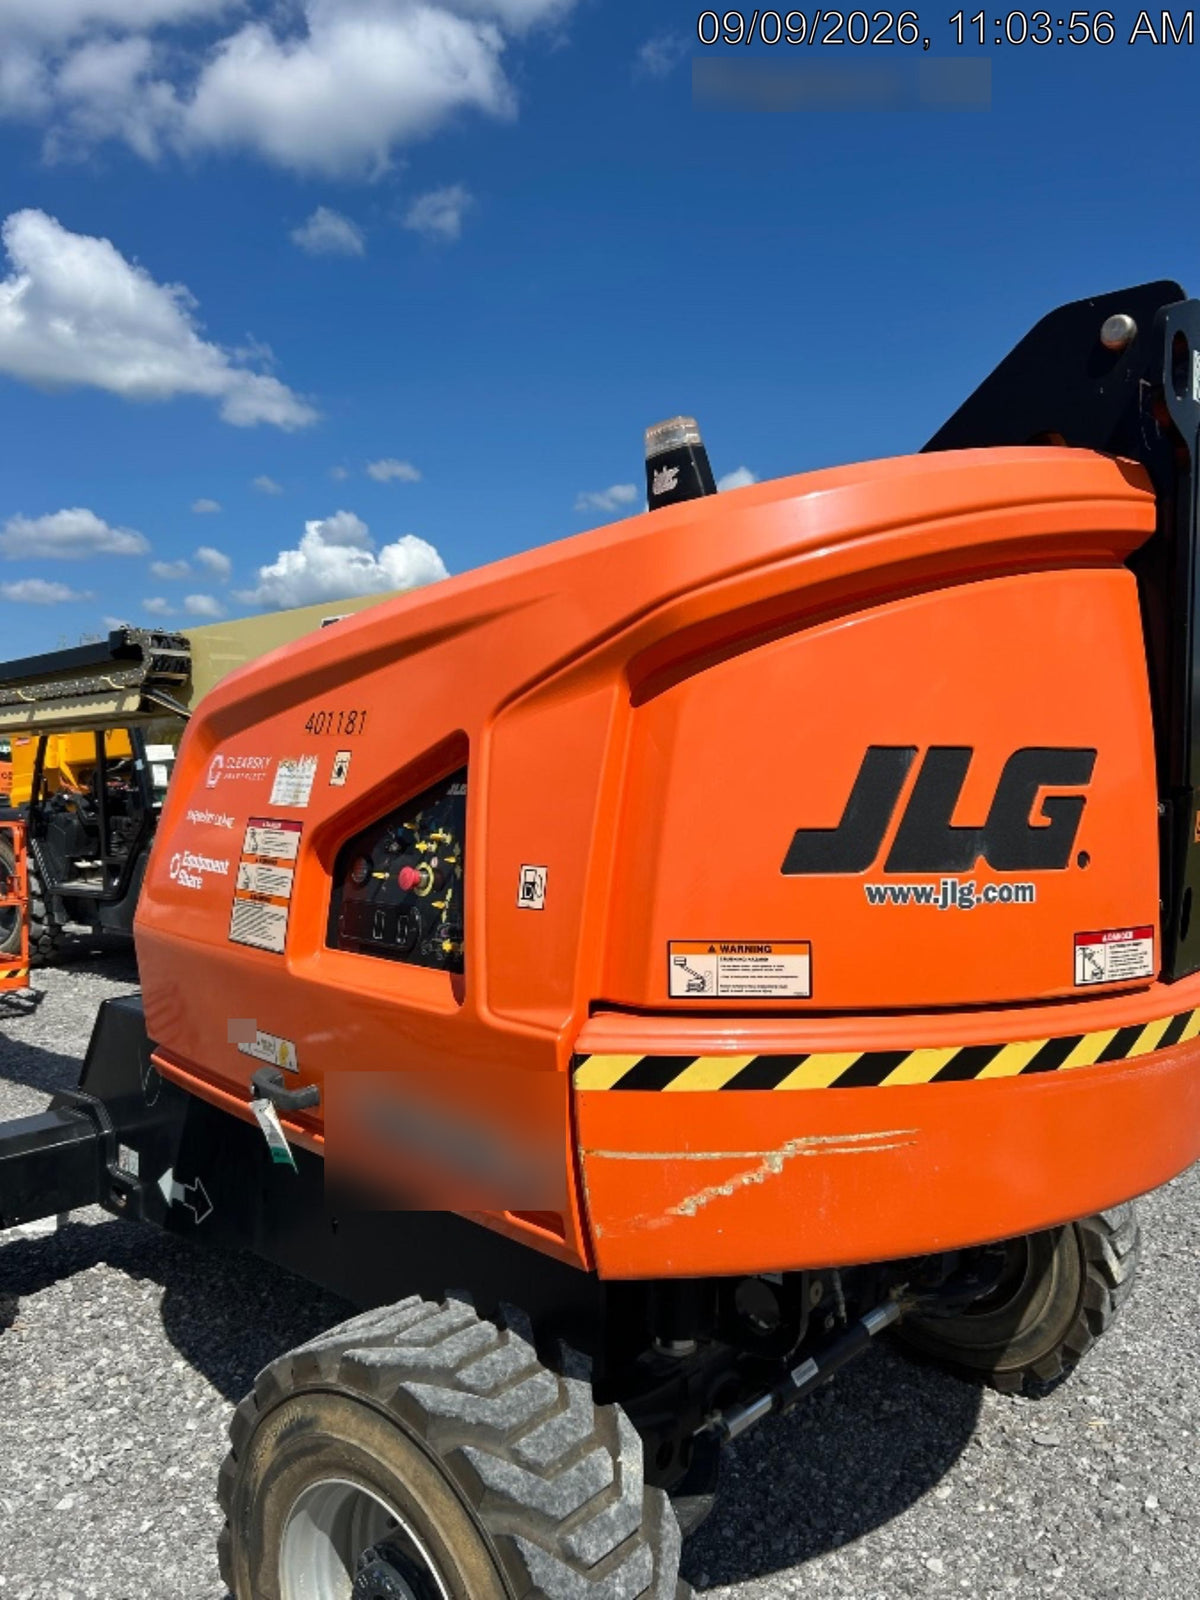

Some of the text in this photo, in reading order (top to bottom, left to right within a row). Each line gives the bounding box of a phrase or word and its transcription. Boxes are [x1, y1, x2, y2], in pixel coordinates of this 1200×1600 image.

[304, 710, 367, 735] 401181
[182, 850, 230, 876] Equipment
[177, 869, 203, 890] Share
[864, 879, 1036, 909] www.jlg.com
[719, 944, 772, 954] WARNING
